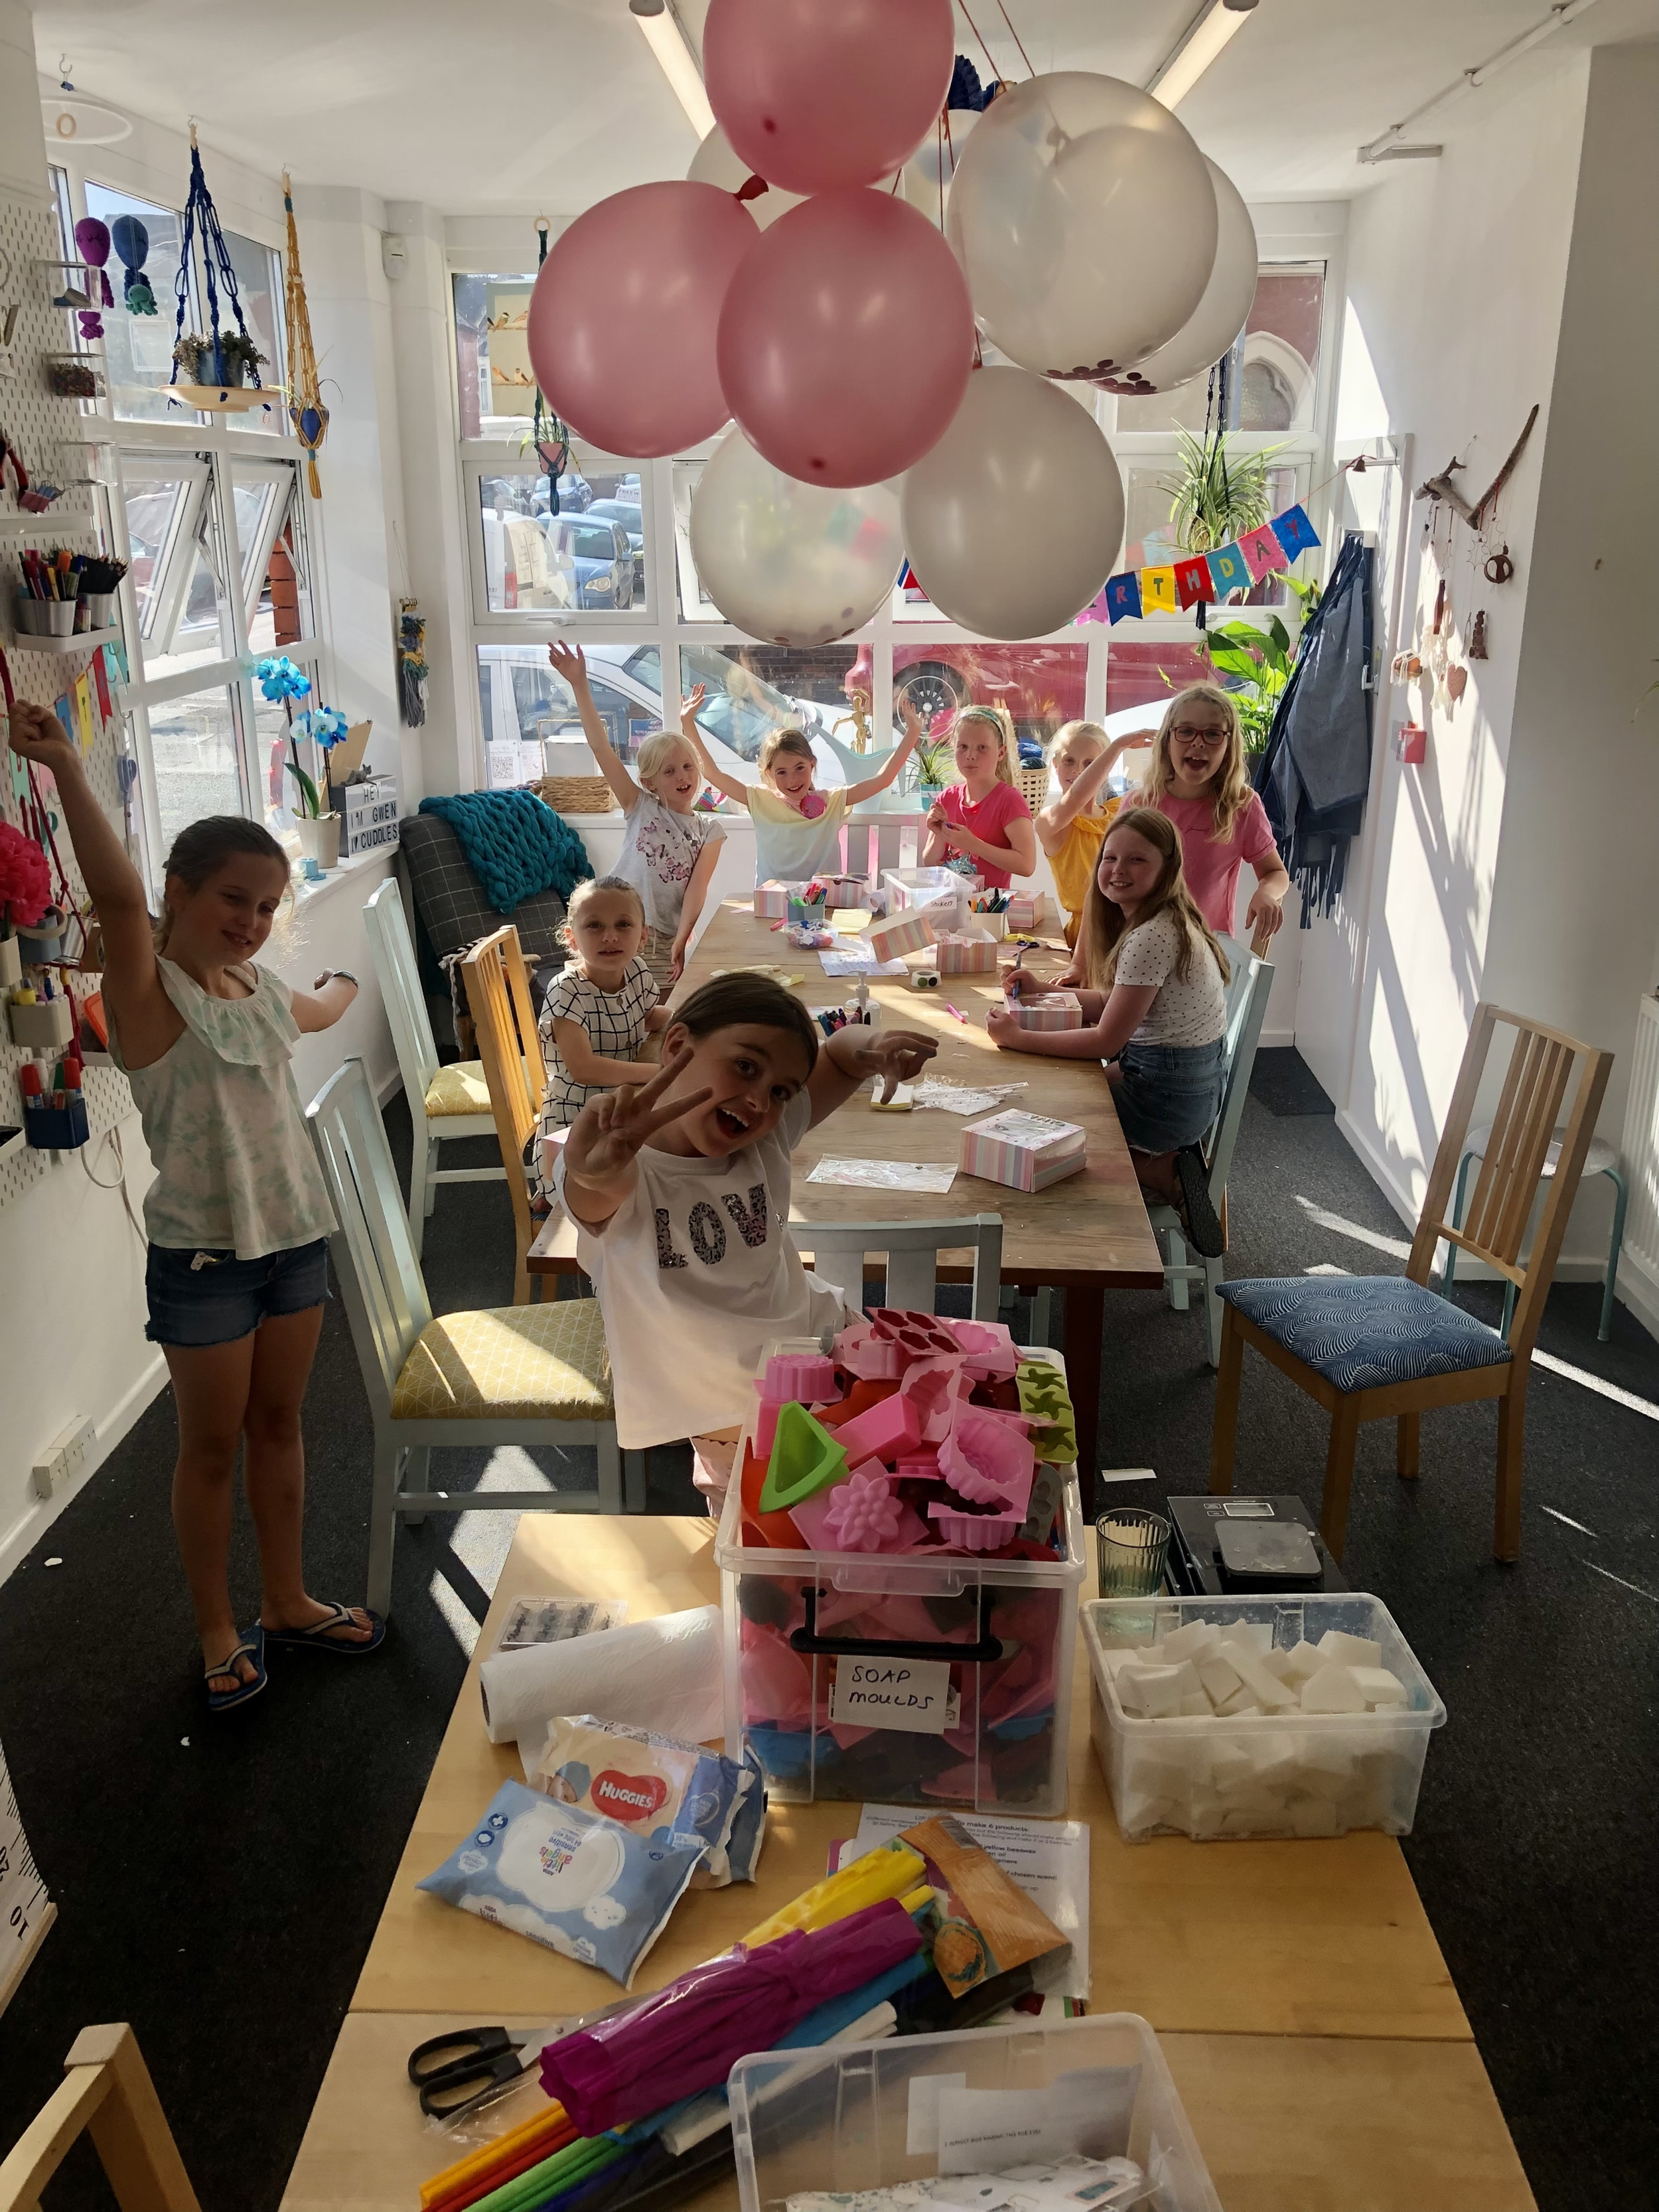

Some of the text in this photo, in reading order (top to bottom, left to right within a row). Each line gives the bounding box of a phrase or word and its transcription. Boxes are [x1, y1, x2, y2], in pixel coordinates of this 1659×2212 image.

[1092, 518, 1301, 608] RTHDAY
[364, 782, 382, 803] HEY
[372, 802, 396, 822] GWEN
[361, 824, 397, 848] CUDDLES
[654, 1183, 785, 1269] LOV
[851, 1666, 911, 1684] SOAP
[599, 1780, 654, 1808] HUGGIES
[548, 1836, 577, 1852] sensitive
[540, 1846, 573, 1864] angels
[541, 1857, 564, 1873] little
[10, 1906, 29, 1941] 10
[526, 1931, 555, 1949] sensitive
